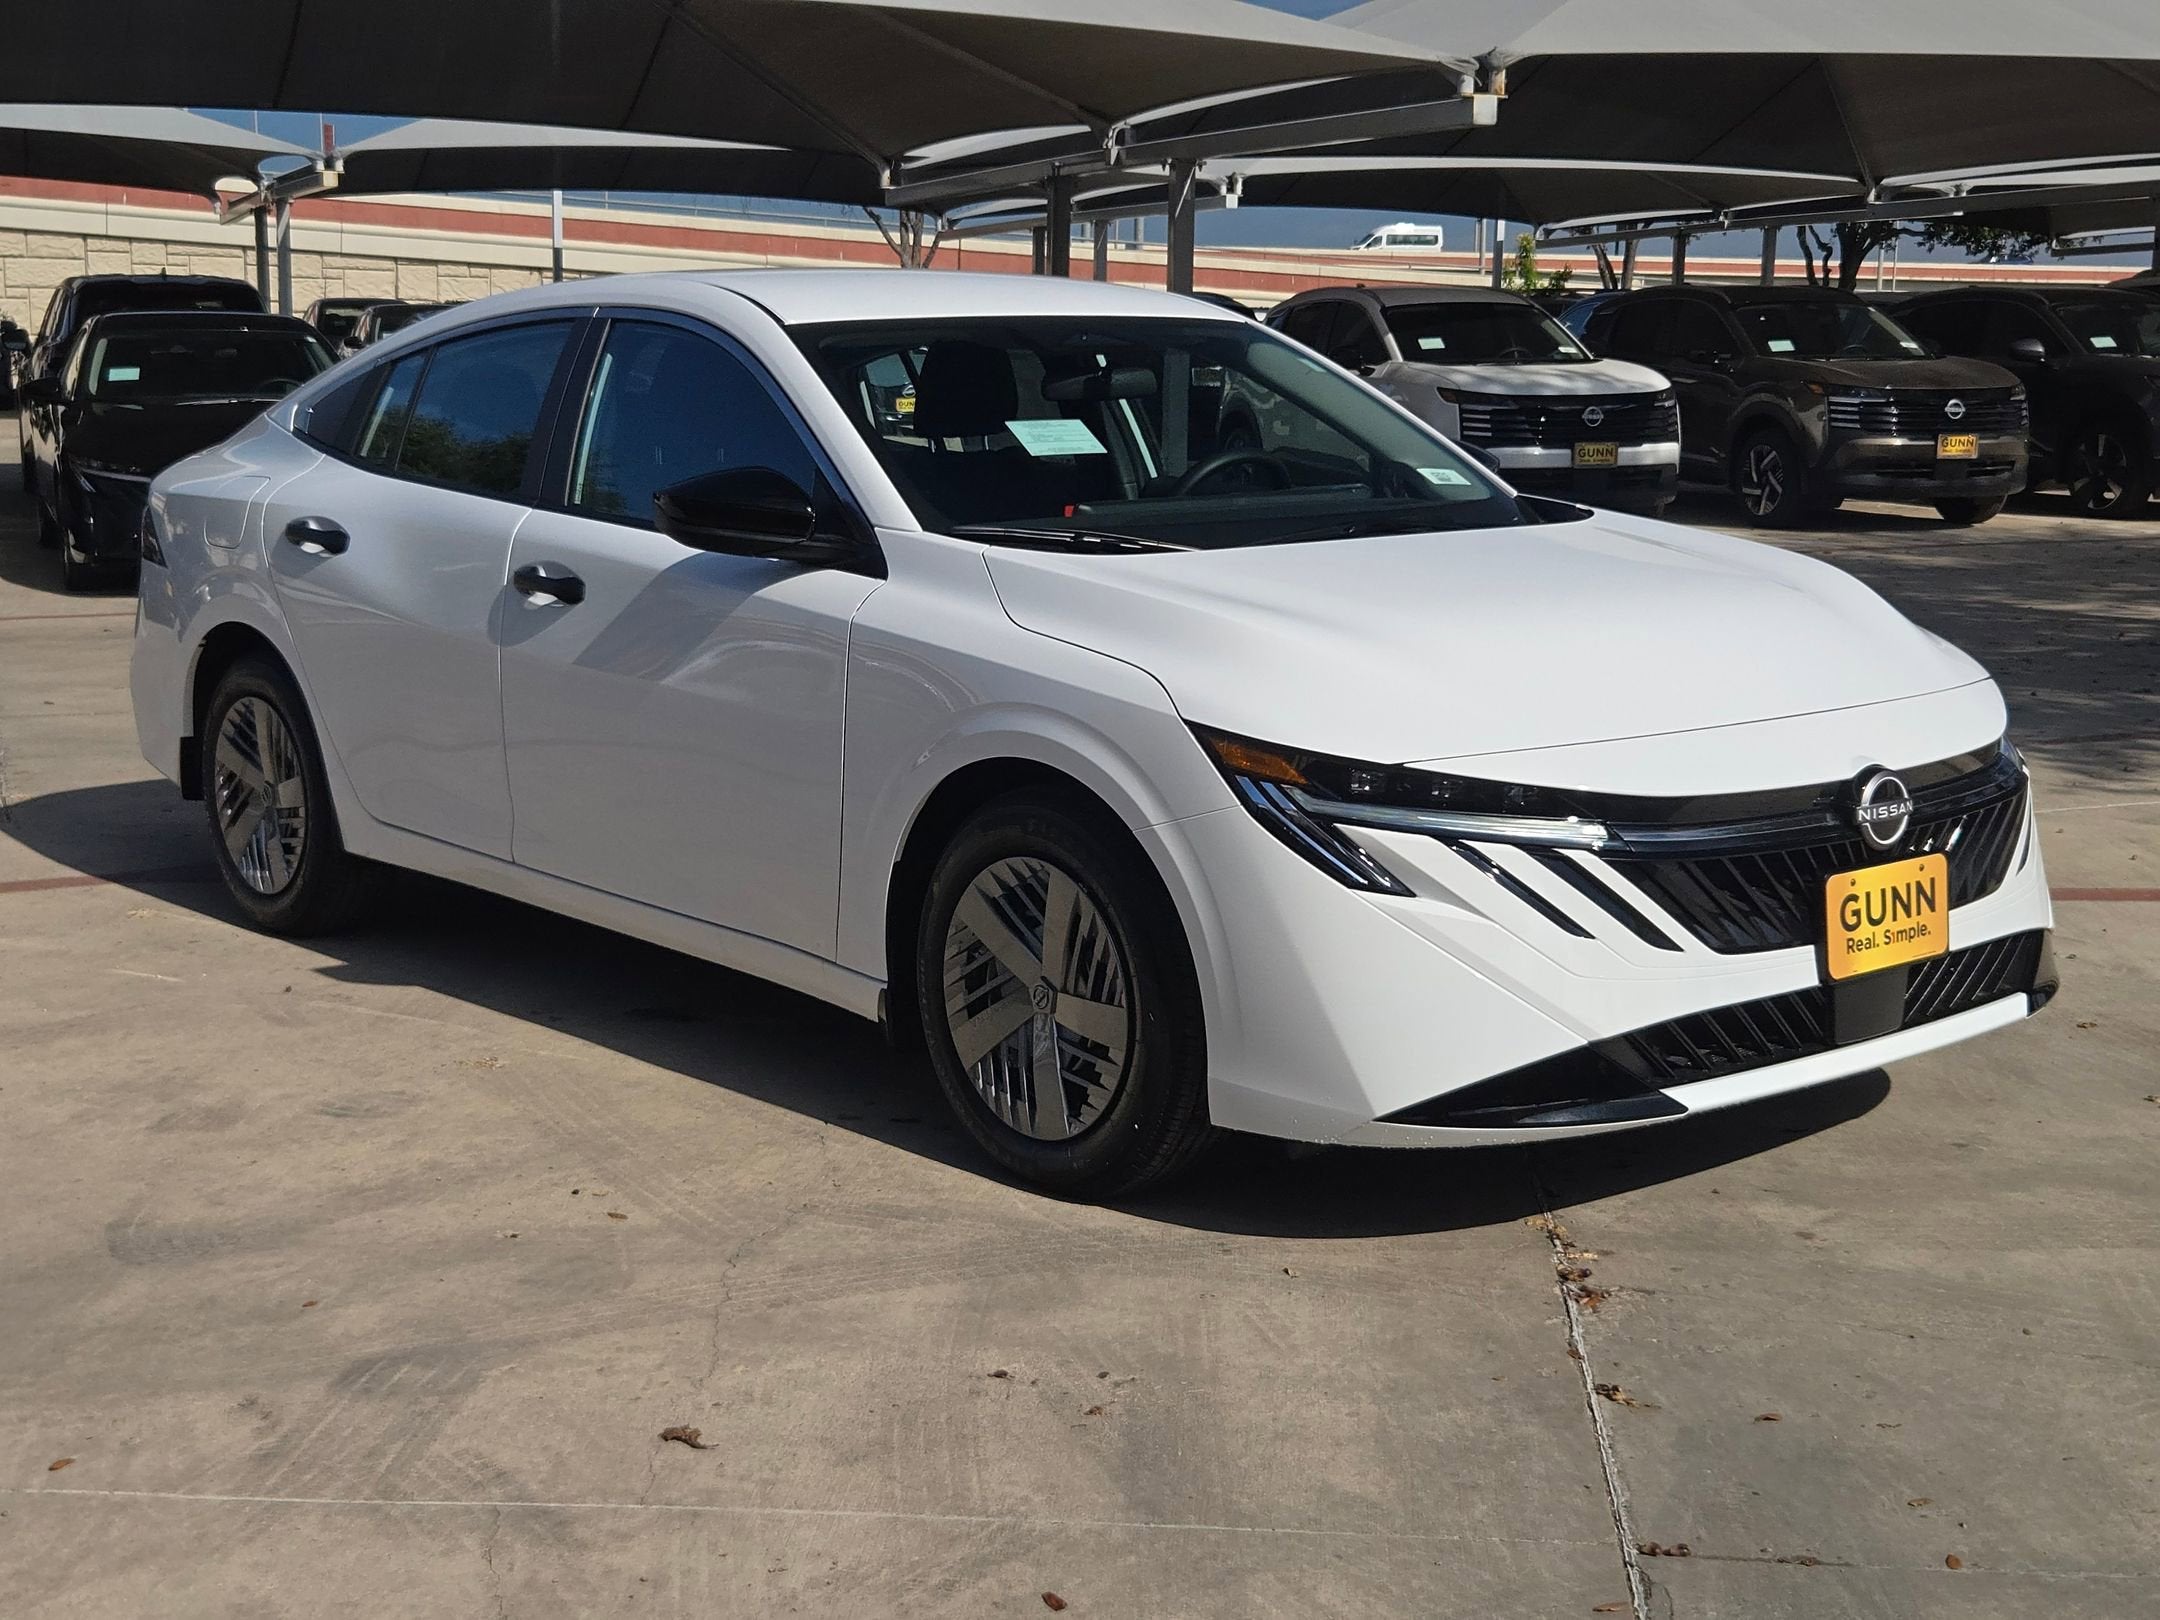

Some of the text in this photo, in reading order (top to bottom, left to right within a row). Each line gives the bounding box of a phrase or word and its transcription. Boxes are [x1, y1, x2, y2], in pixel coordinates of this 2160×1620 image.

[1578, 447, 1614, 458] GUNN
[1941, 438, 1974, 448] GUNN
[1858, 800, 1913, 821] NISSAN
[1840, 877, 1936, 932] GUNN
[1846, 931, 1880, 955] Real.
